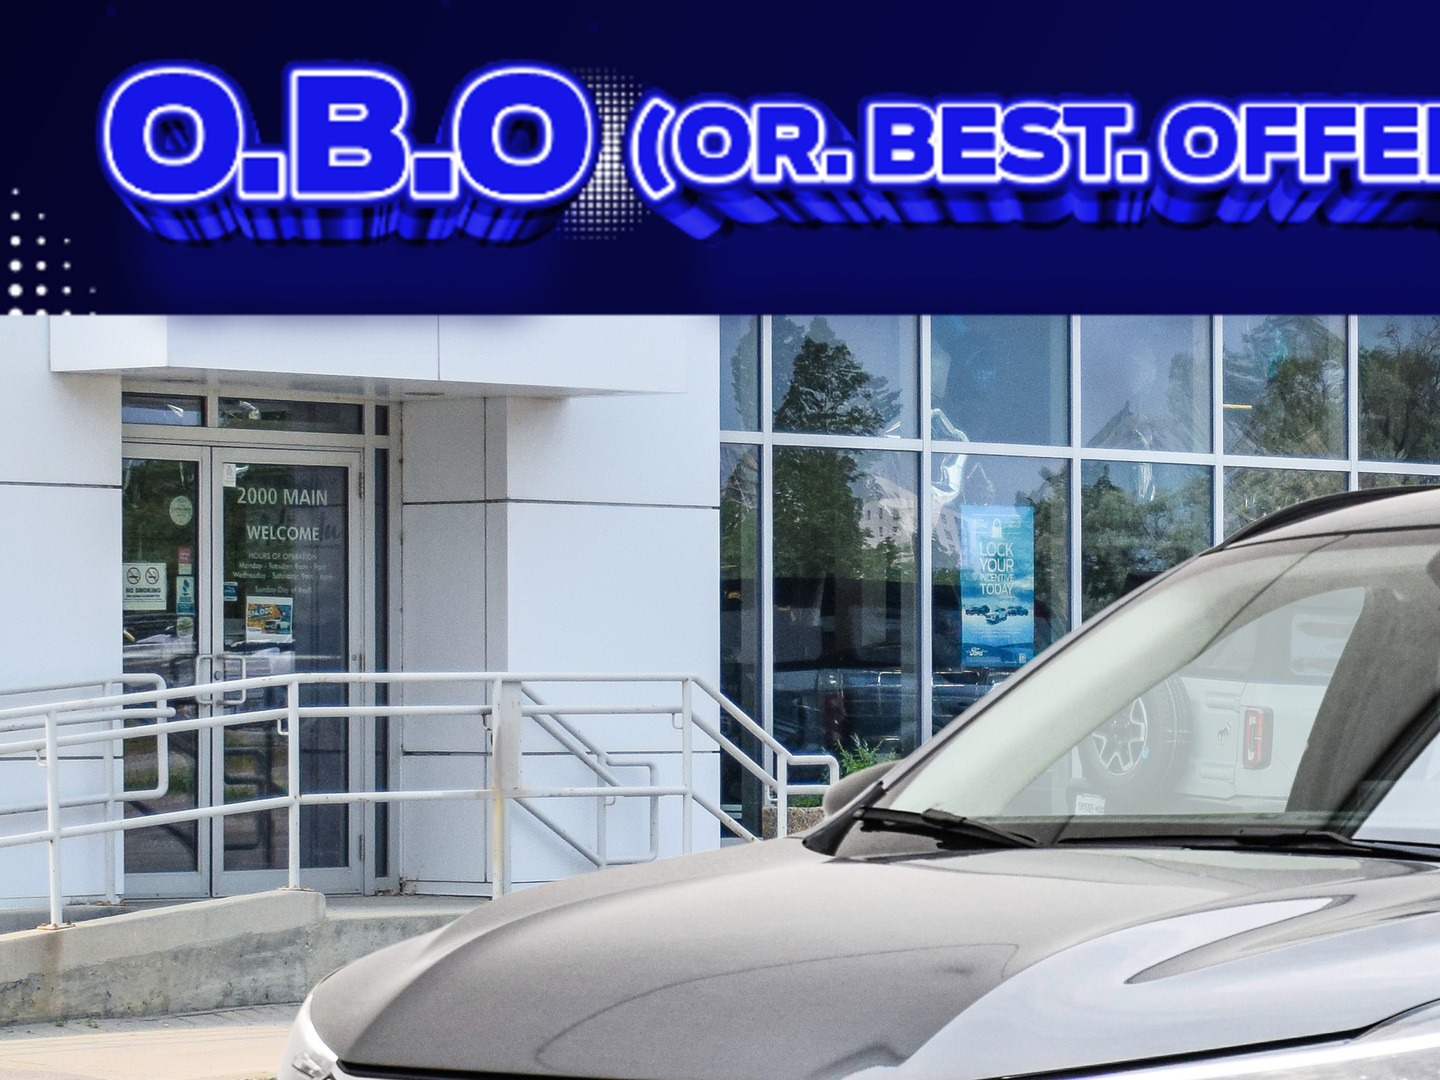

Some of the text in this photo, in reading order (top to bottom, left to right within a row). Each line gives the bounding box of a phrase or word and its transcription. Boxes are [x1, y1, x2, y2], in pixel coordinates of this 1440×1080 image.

[236, 487, 328, 506] 2000 MAIN
[246, 525, 320, 541] WELCOME
[248, 552, 318, 560] HOURS OF OPERATION
[979, 541, 1014, 558] LOCK
[979, 557, 1015, 573] YOUR
[980, 573, 1015, 582] INCENTIVE
[979, 582, 1013, 596] TODAY
